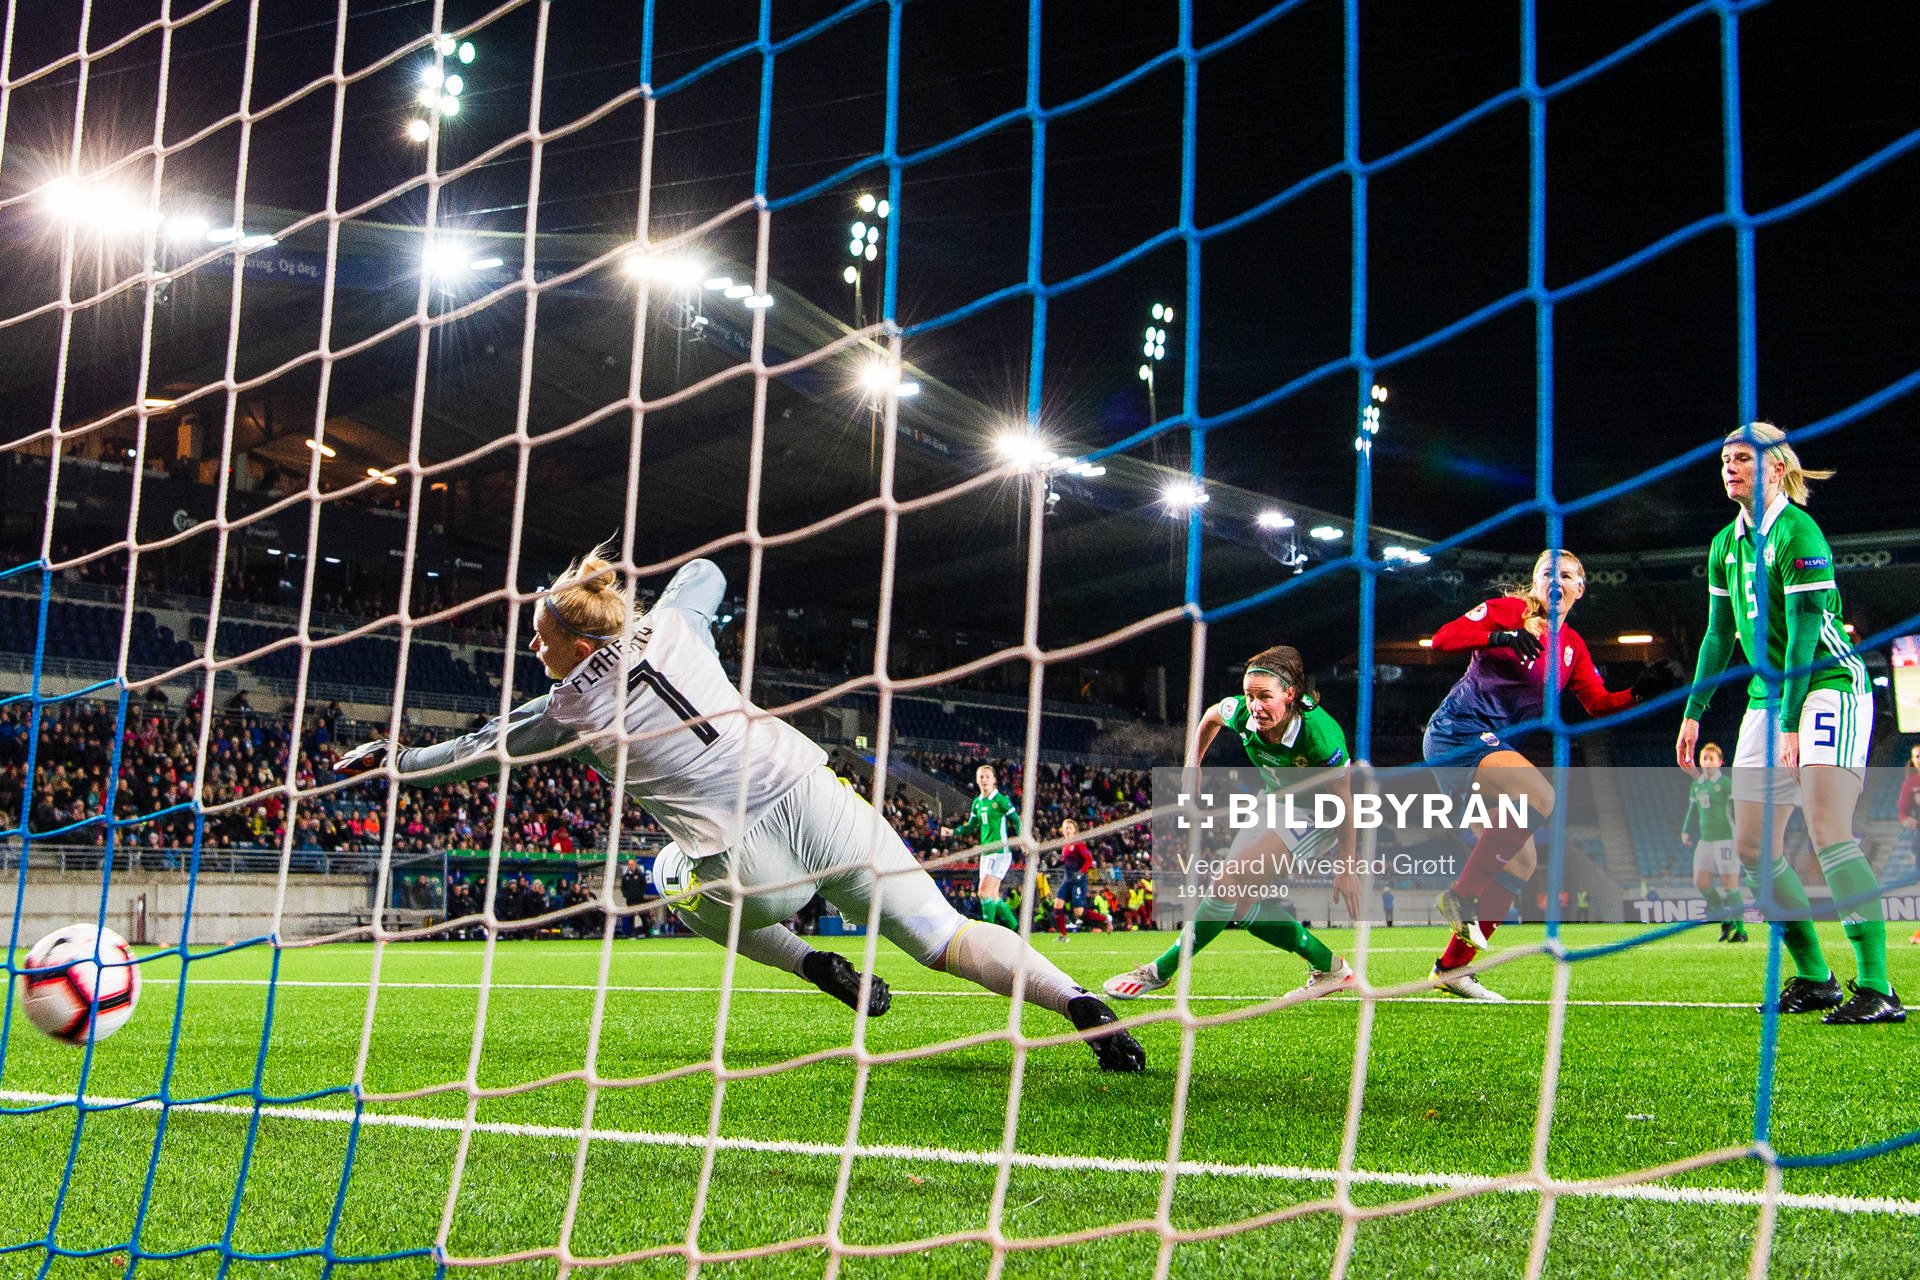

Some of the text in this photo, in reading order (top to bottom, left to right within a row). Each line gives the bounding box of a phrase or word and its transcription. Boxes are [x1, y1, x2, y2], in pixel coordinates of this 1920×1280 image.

[1814, 712, 1836, 747] 5
[1719, 847, 1732, 861] 10
[1633, 900, 1708, 923] TINE
[1881, 897, 1920, 921] IN
